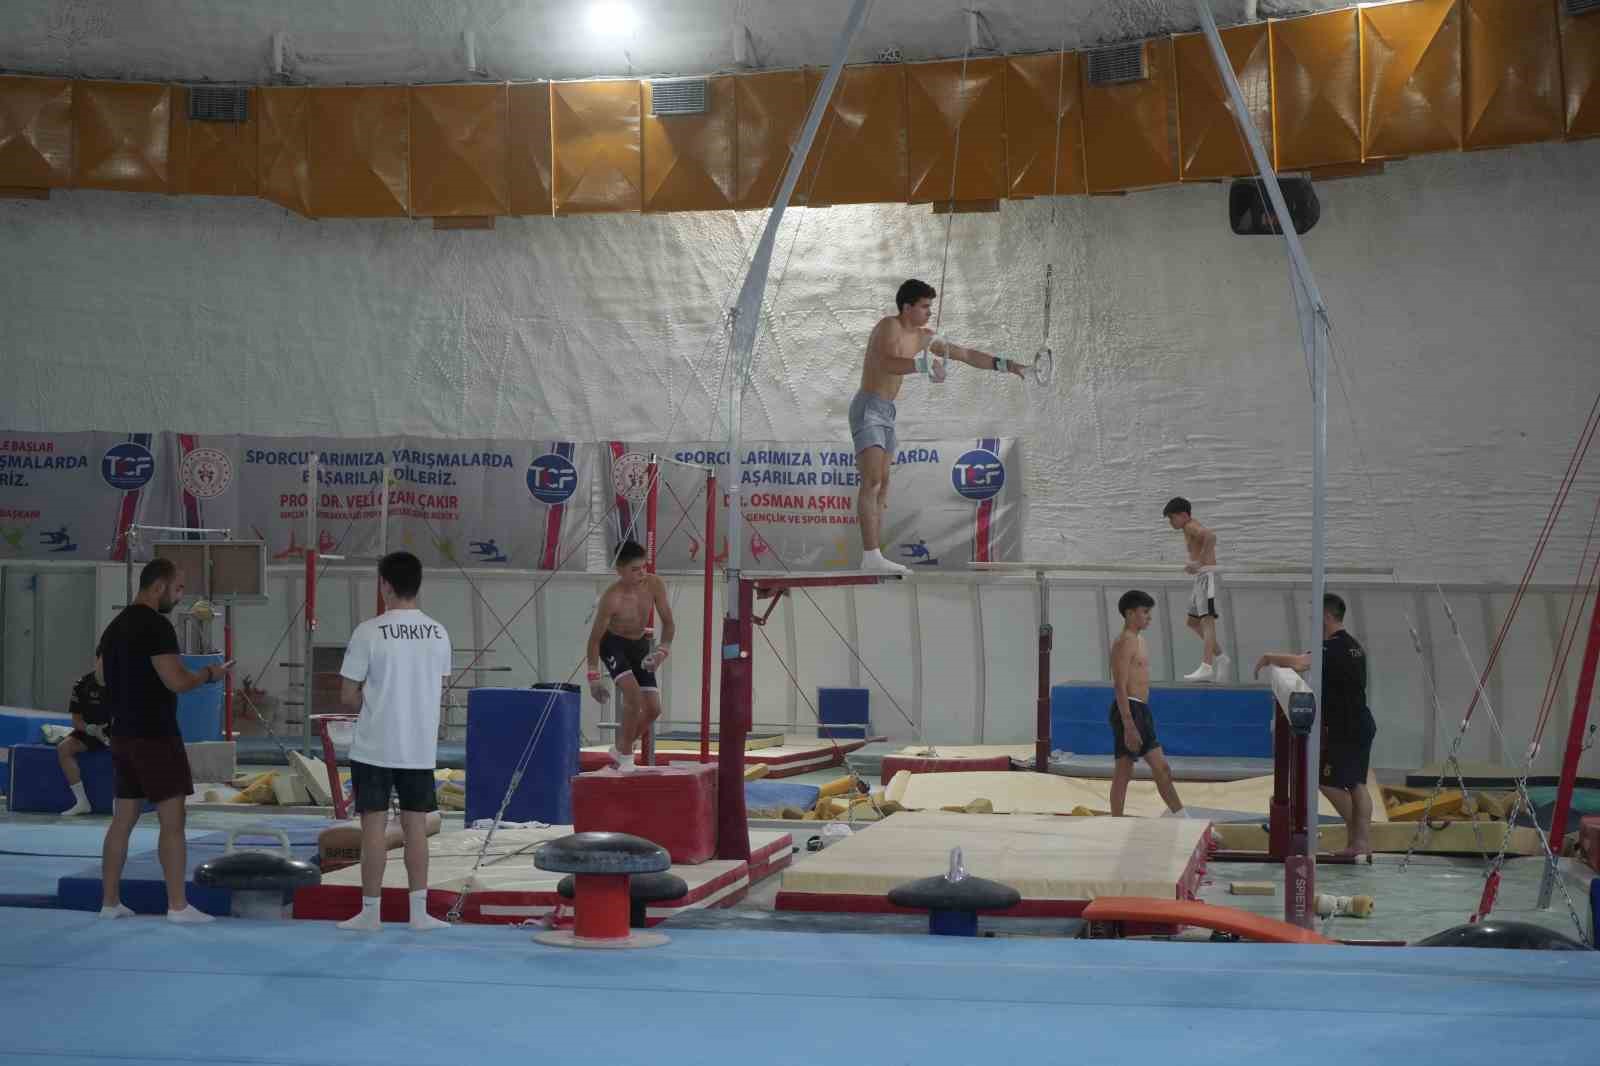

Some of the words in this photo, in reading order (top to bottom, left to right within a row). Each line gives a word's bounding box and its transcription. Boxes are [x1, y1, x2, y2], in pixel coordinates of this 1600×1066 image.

[105, 455, 151, 477] TCF
[246, 449, 385, 467] SPORCUARIMIZA
[392, 449, 513, 469] YARIŞMALARDA
[303, 469, 385, 488] BŞARILA
[393, 466, 457, 486] DİLERİZ.
[530, 466, 574, 489] TCF
[740, 470, 818, 487] AŞARILAR
[954, 464, 1002, 486] TCF
[346, 490, 377, 508] VELİ
[378, 491, 416, 507] ZAN
[419, 494, 459, 512] ÇAKIR
[750, 493, 804, 510] OSMAN
[807, 494, 852, 513] AŞKIN
[787, 513, 801, 524] VE
